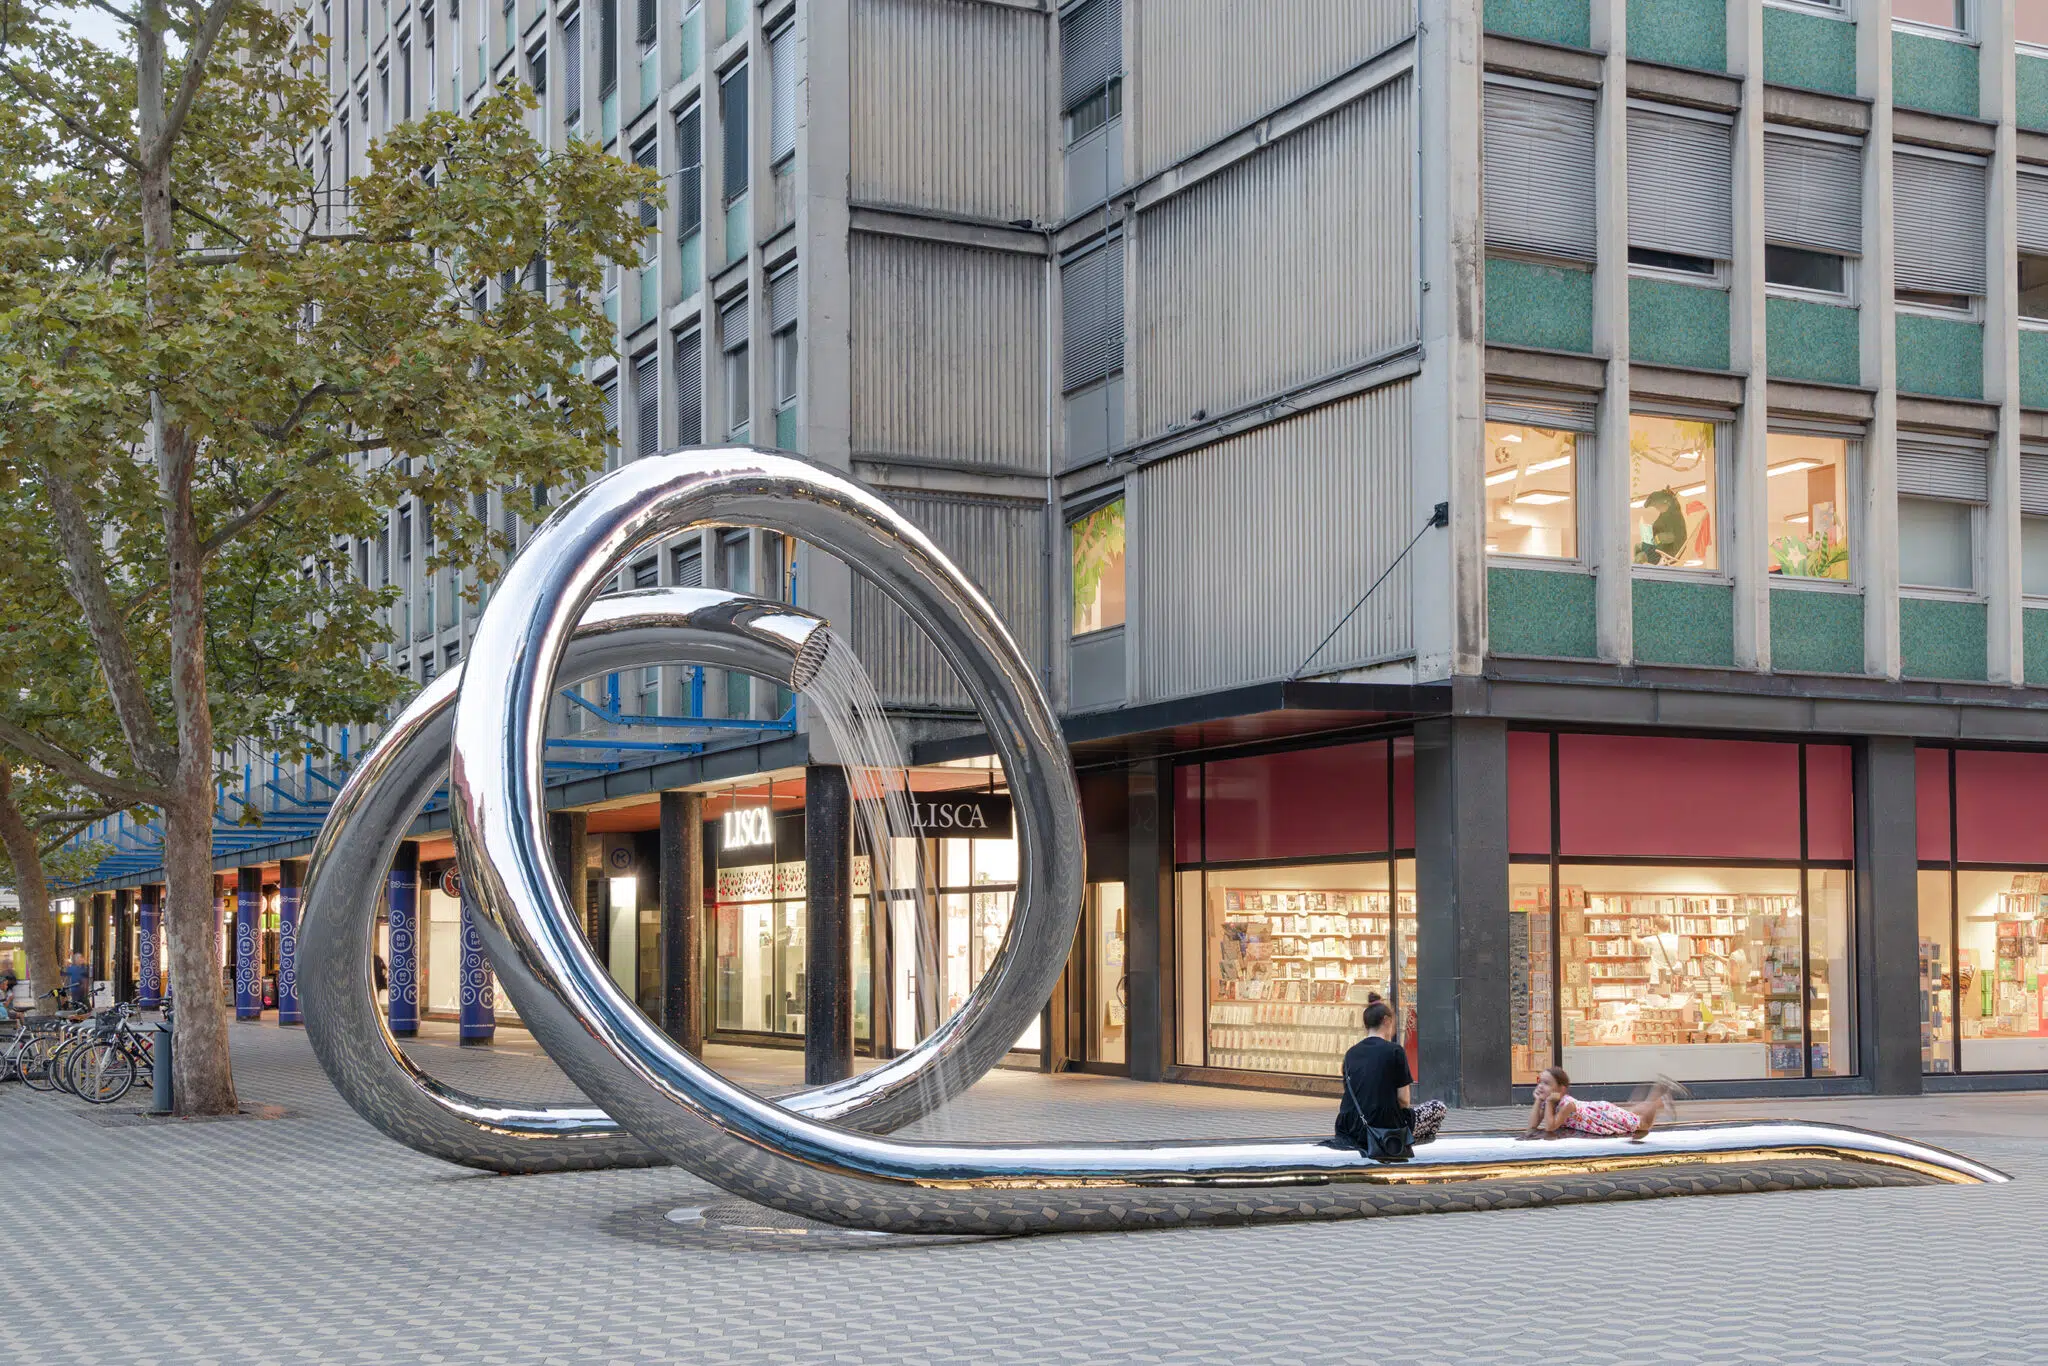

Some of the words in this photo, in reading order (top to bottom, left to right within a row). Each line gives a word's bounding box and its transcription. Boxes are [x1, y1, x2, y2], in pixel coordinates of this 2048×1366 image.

[723, 806, 773, 849] LISCA
[910, 803, 988, 829] LISCA
[396, 934, 406, 942] 80
